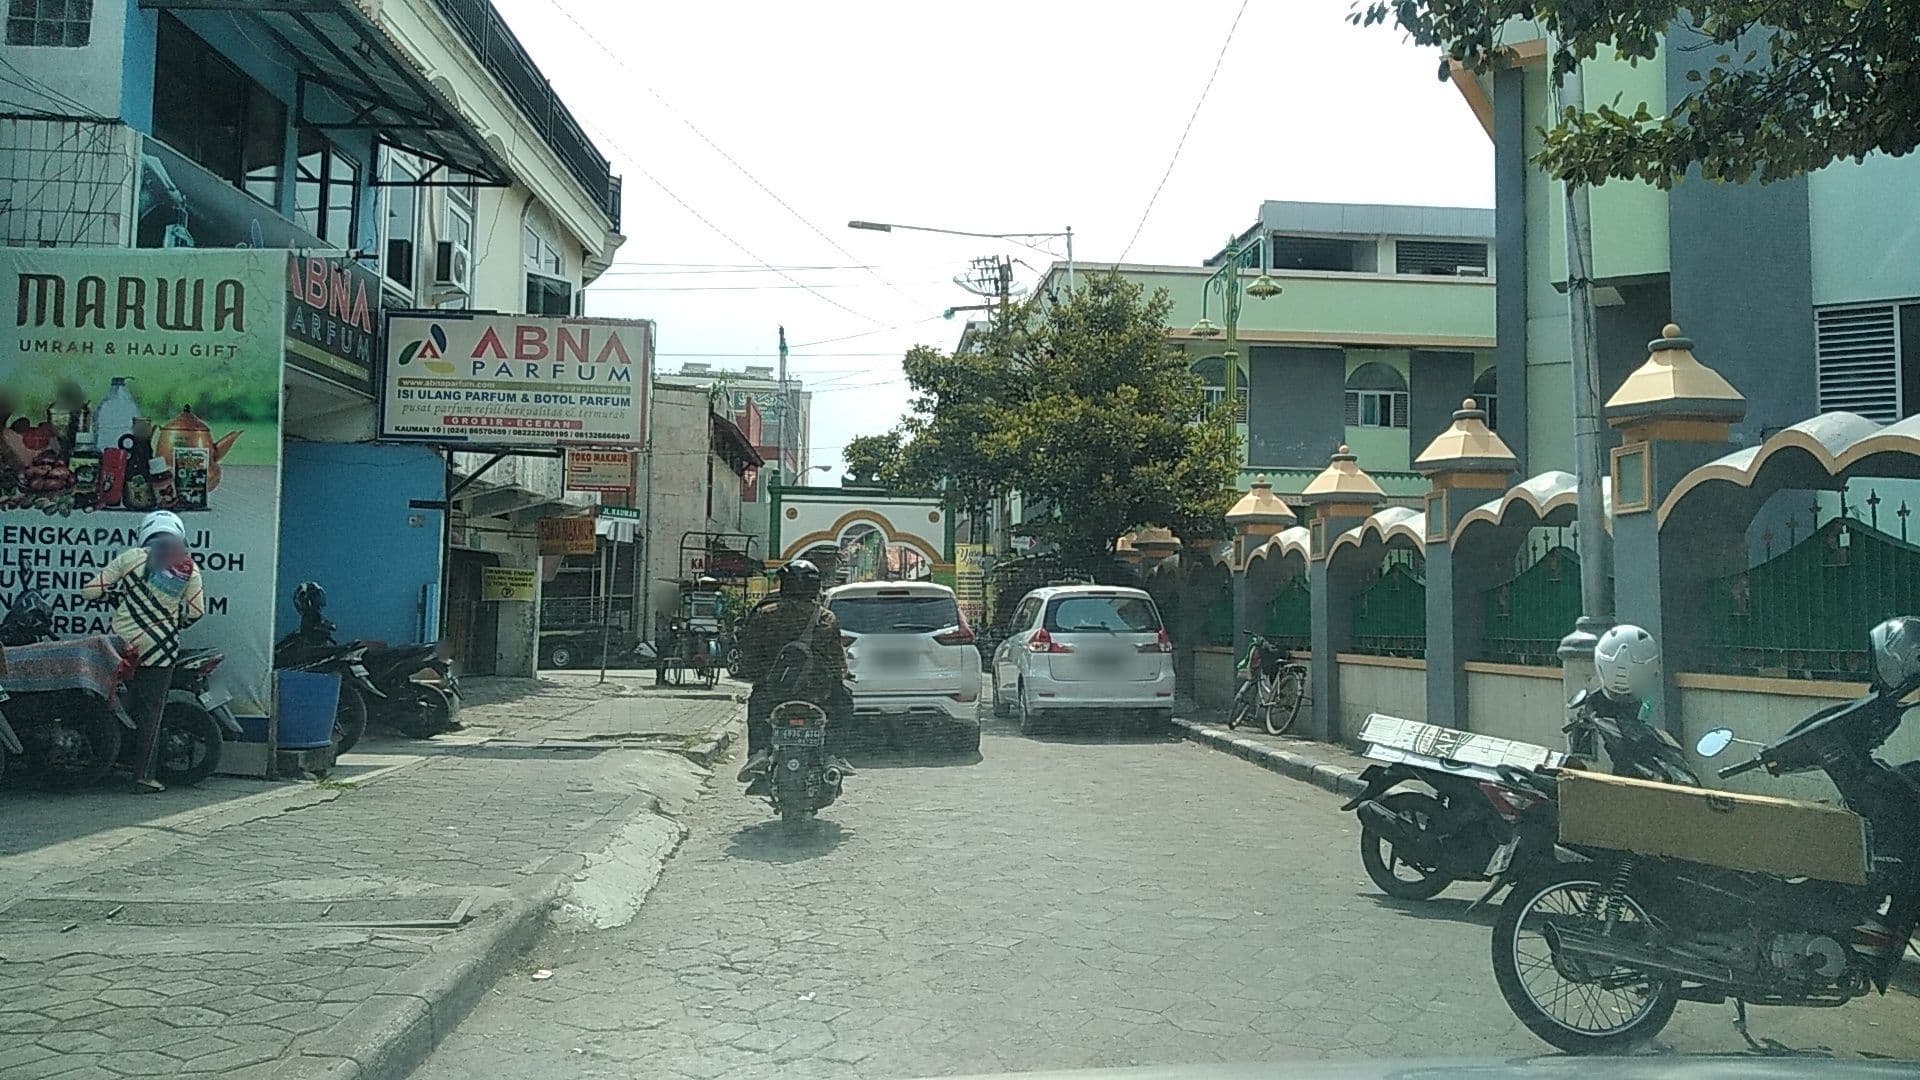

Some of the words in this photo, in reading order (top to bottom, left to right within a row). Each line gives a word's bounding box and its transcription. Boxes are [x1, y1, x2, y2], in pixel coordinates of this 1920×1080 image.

[17, 273, 245, 332] MARWA
[292, 305, 370, 363] ARFUM
[470, 325, 632, 364] ABNA
[19, 339, 94, 354] UMRAH
[105, 342, 116, 355] &
[127, 342, 179, 356] HAJJ
[190, 344, 238, 358] GIFT
[472, 360, 631, 382] PARFUM
[398, 389, 414, 399] ISI
[418, 389, 461, 400] ULANG
[465, 391, 517, 402] PARFUM
[521, 393, 529, 403] &
[534, 394, 575, 404] BOTOL
[580, 395, 631, 407] PARFUM
[402, 404, 431, 415] pusat
[433, 402, 472, 415] parfum
[452, 417, 503, 426] GROSIR
[517, 420, 571, 429] ECERAN
[571, 452, 592, 461] TOKO
[593, 453, 628, 462] MAKMUR
[2, 525, 142, 547] ENGKAPAN
[2, 547, 51, 567] LEH
[189, 552, 244, 571] ROH
